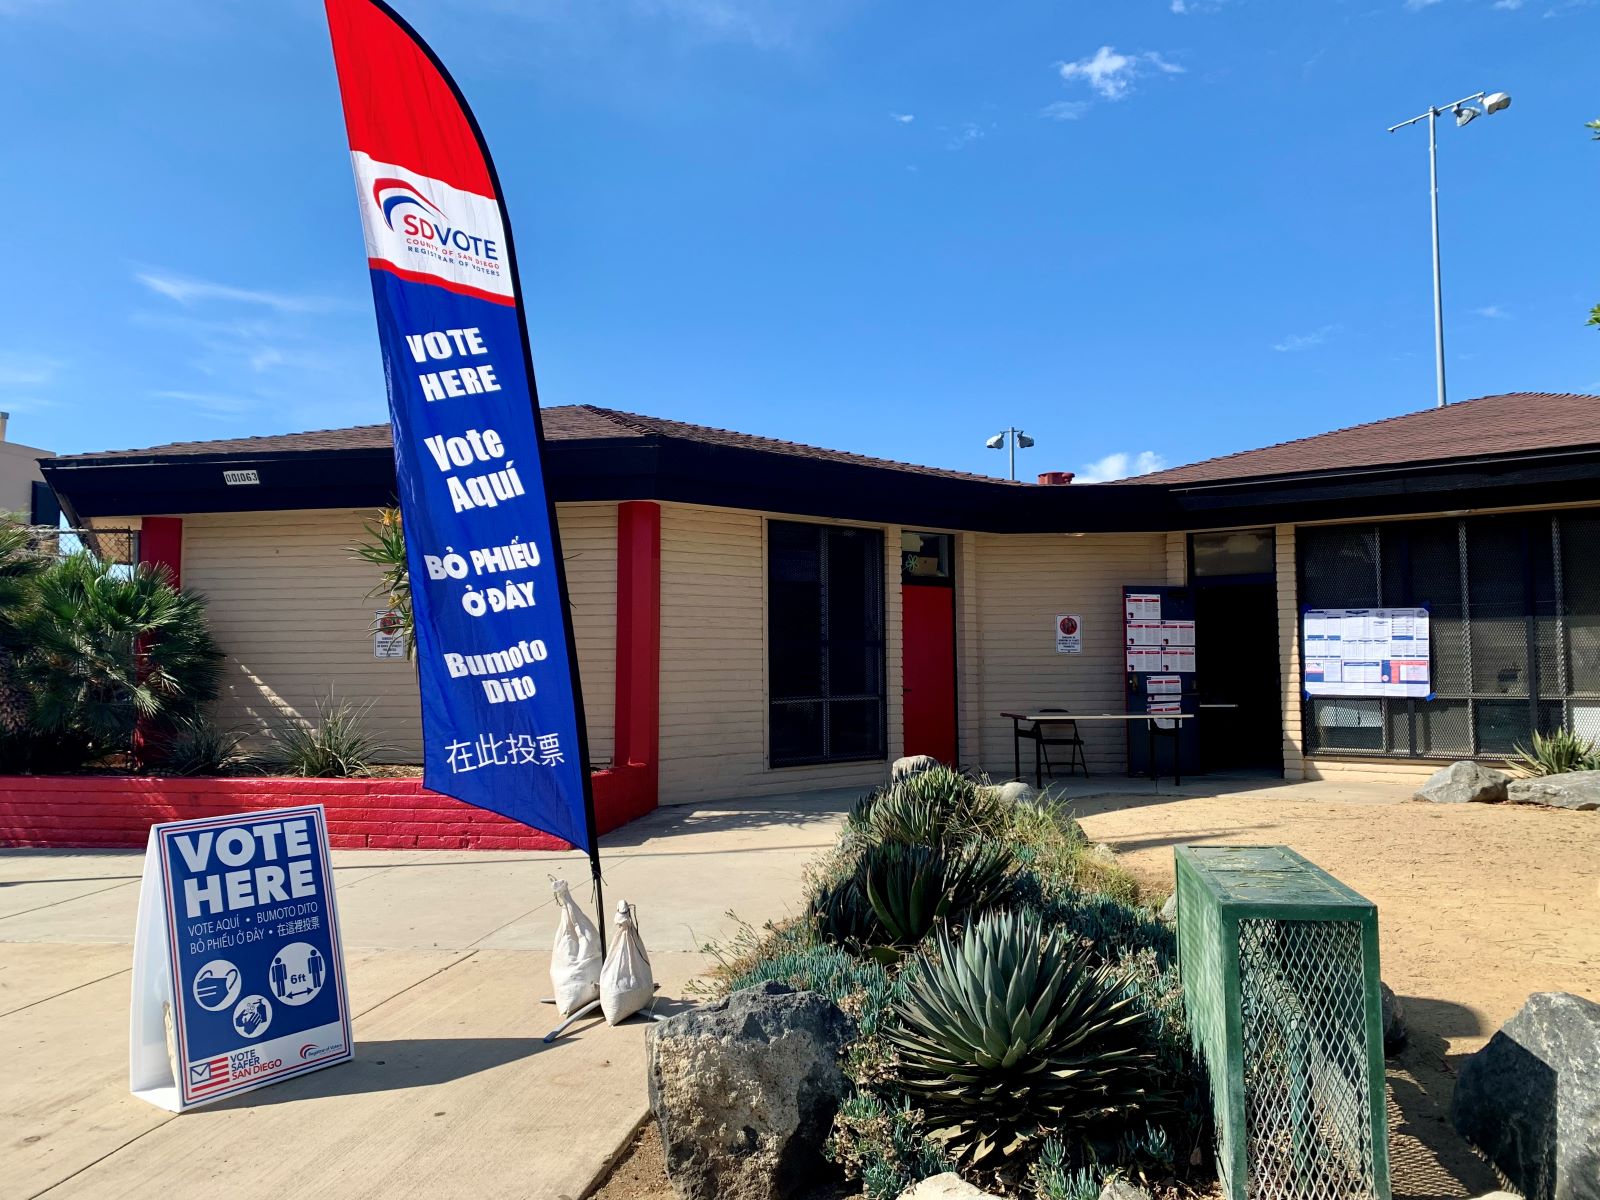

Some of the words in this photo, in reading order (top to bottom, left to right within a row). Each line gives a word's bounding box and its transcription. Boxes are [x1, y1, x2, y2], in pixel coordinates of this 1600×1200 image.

[403, 214, 498, 260] SDVOTE
[406, 238, 439, 252] COUNTY
[442, 248, 454, 256] OF
[458, 253, 473, 262] SAN
[475, 259, 500, 270] DIEGO
[408, 246, 454, 264] REGISTRAR
[458, 260, 469, 268] OF
[472, 264, 500, 277] VOTERS
[406, 327, 488, 363] VOTE
[418, 364, 502, 402] HERE
[424, 428, 505, 473] Vote
[446, 460, 525, 514] Aquí
[424, 547, 469, 581] BỎ
[469, 534, 541, 576] PHIẾU
[461, 583, 488, 617] Ở
[488, 580, 536, 613] ĐÂY
[444, 638, 548, 679] Bumoto
[482, 674, 536, 704] Dito
[444, 732, 565, 775] 在此投票
[174, 819, 312, 872] VOTE
[184, 859, 316, 919] HERE
[188, 920, 215, 938] VOTE
[216, 914, 240, 934] AQUÍ
[256, 905, 297, 924] BUMOTO
[298, 901, 318, 917] DITO
[190, 938, 205, 954] BỎ
[207, 932, 235, 952] PHIẾU
[246, 927, 266, 944] ĐÂY
[290, 973, 306, 985] 6ft
[230, 1049, 256, 1063] VOTE
[231, 1056, 260, 1072] SAFER
[232, 1066, 254, 1081] SAN
[254, 1058, 282, 1073] DIEGO
